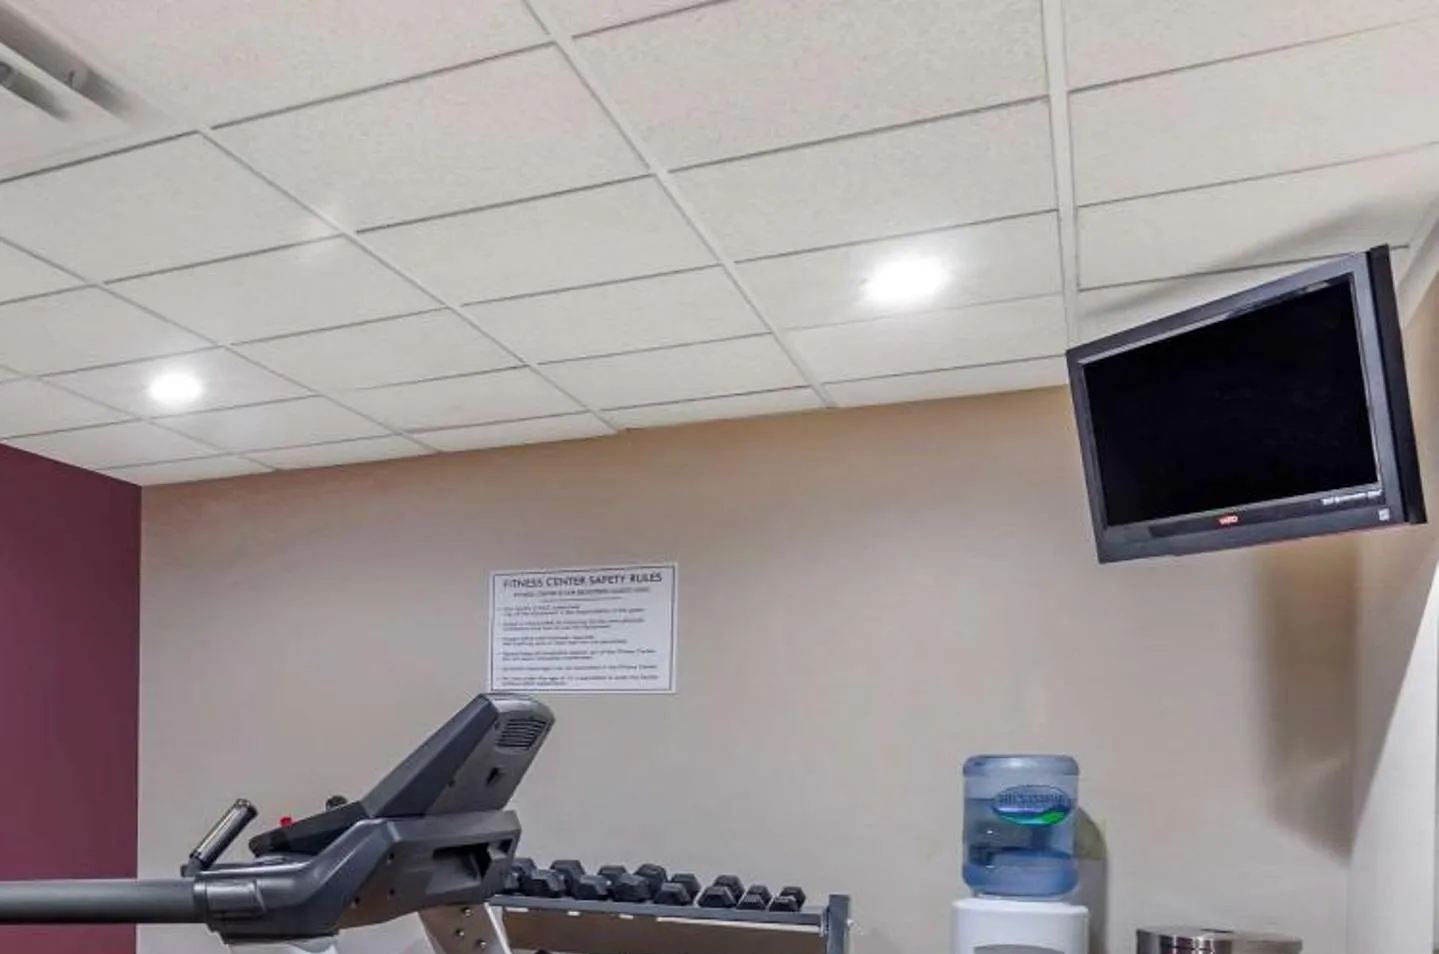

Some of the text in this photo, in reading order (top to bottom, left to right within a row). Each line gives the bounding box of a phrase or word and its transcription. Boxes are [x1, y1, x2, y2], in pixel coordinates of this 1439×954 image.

[503, 571, 663, 590] FITNESS CENTER SAFETY RULES
